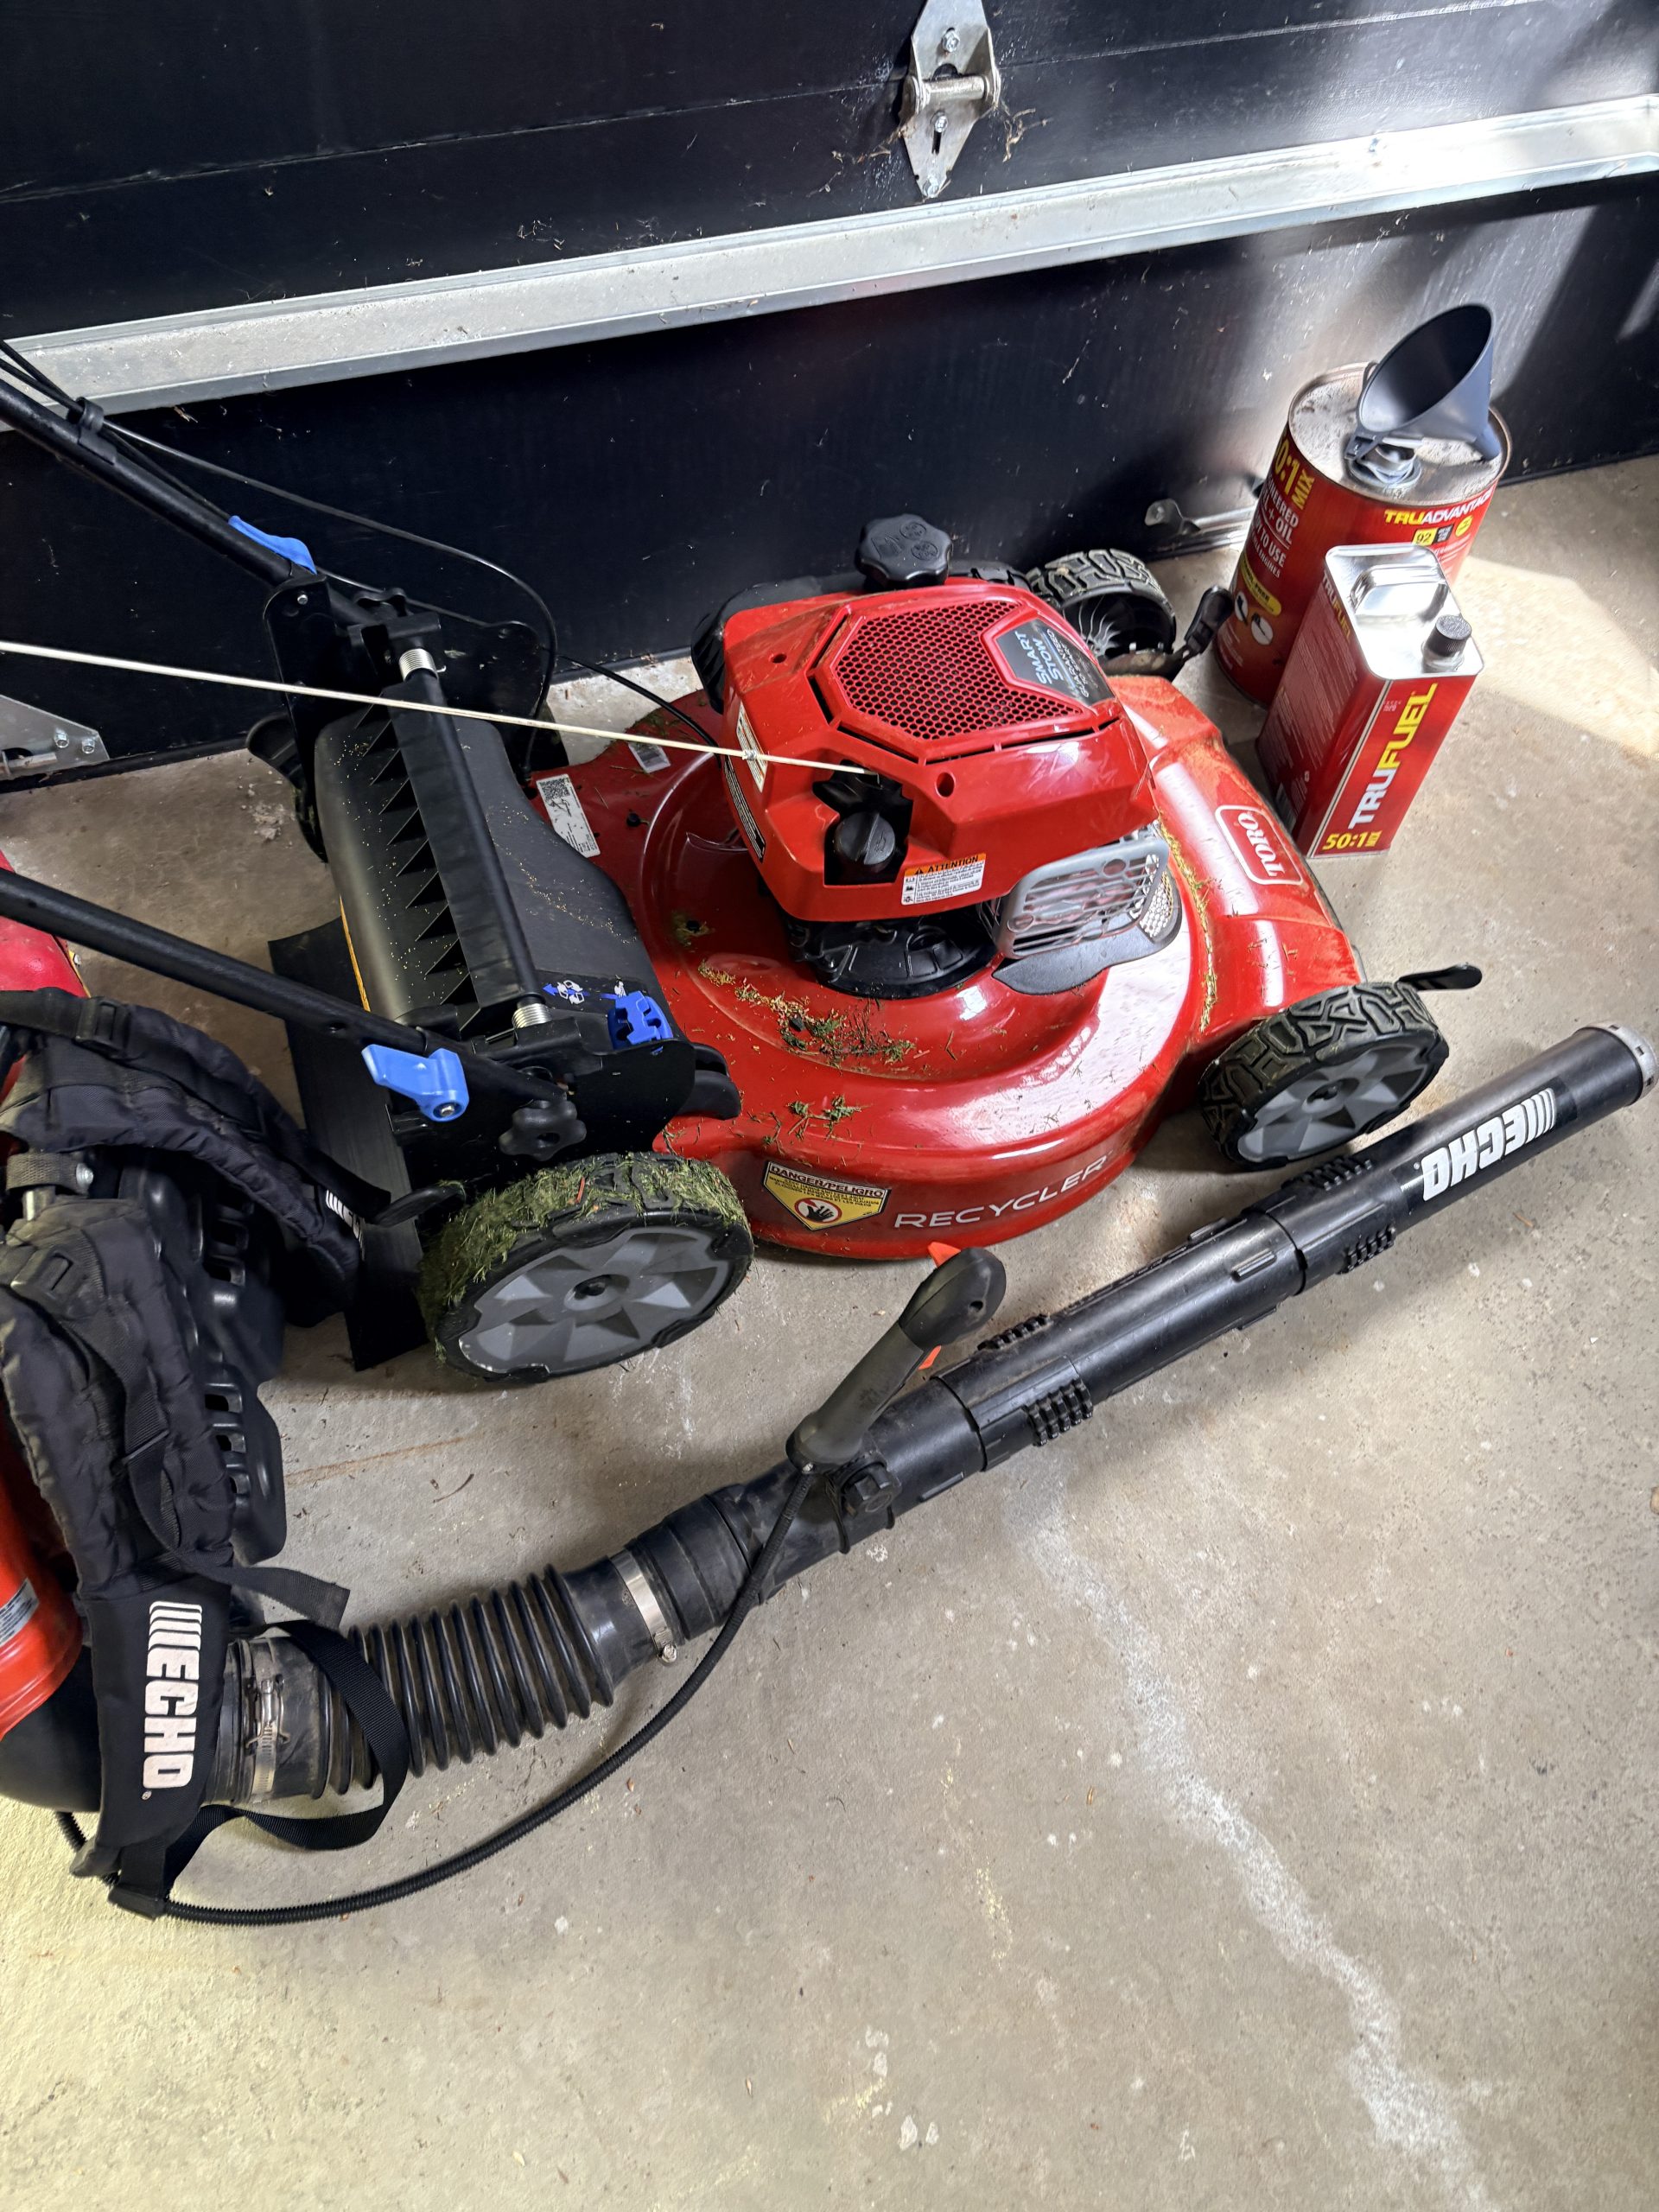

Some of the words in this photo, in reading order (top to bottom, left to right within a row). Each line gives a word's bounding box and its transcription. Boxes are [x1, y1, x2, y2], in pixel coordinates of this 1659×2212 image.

[1274, 438, 1300, 495] 0:1
[1291, 468, 1315, 510] MIX
[1261, 527, 1269, 548] TO
[1268, 541, 1287, 568] USE
[1275, 518, 1293, 545] OIL
[1323, 569, 1352, 639] TRUFUEL
[1014, 630, 1052, 684] SMART
[1033, 637, 1064, 681] STOW
[1047, 628, 1089, 697] GUARANTEED
[1347, 683, 1439, 830] TRUFUEL
[927, 855, 979, 873] ATTENTION
[1237, 812, 1286, 877] TORO
[1322, 832, 1365, 850] 50:1
[1421, 1103, 1528, 1202] ECHO
[771, 1166, 884, 1198] DANGER/PELIGRO
[894, 1155, 1108, 1228] RECYCLER
[142, 1646, 202, 1789] ECHO
